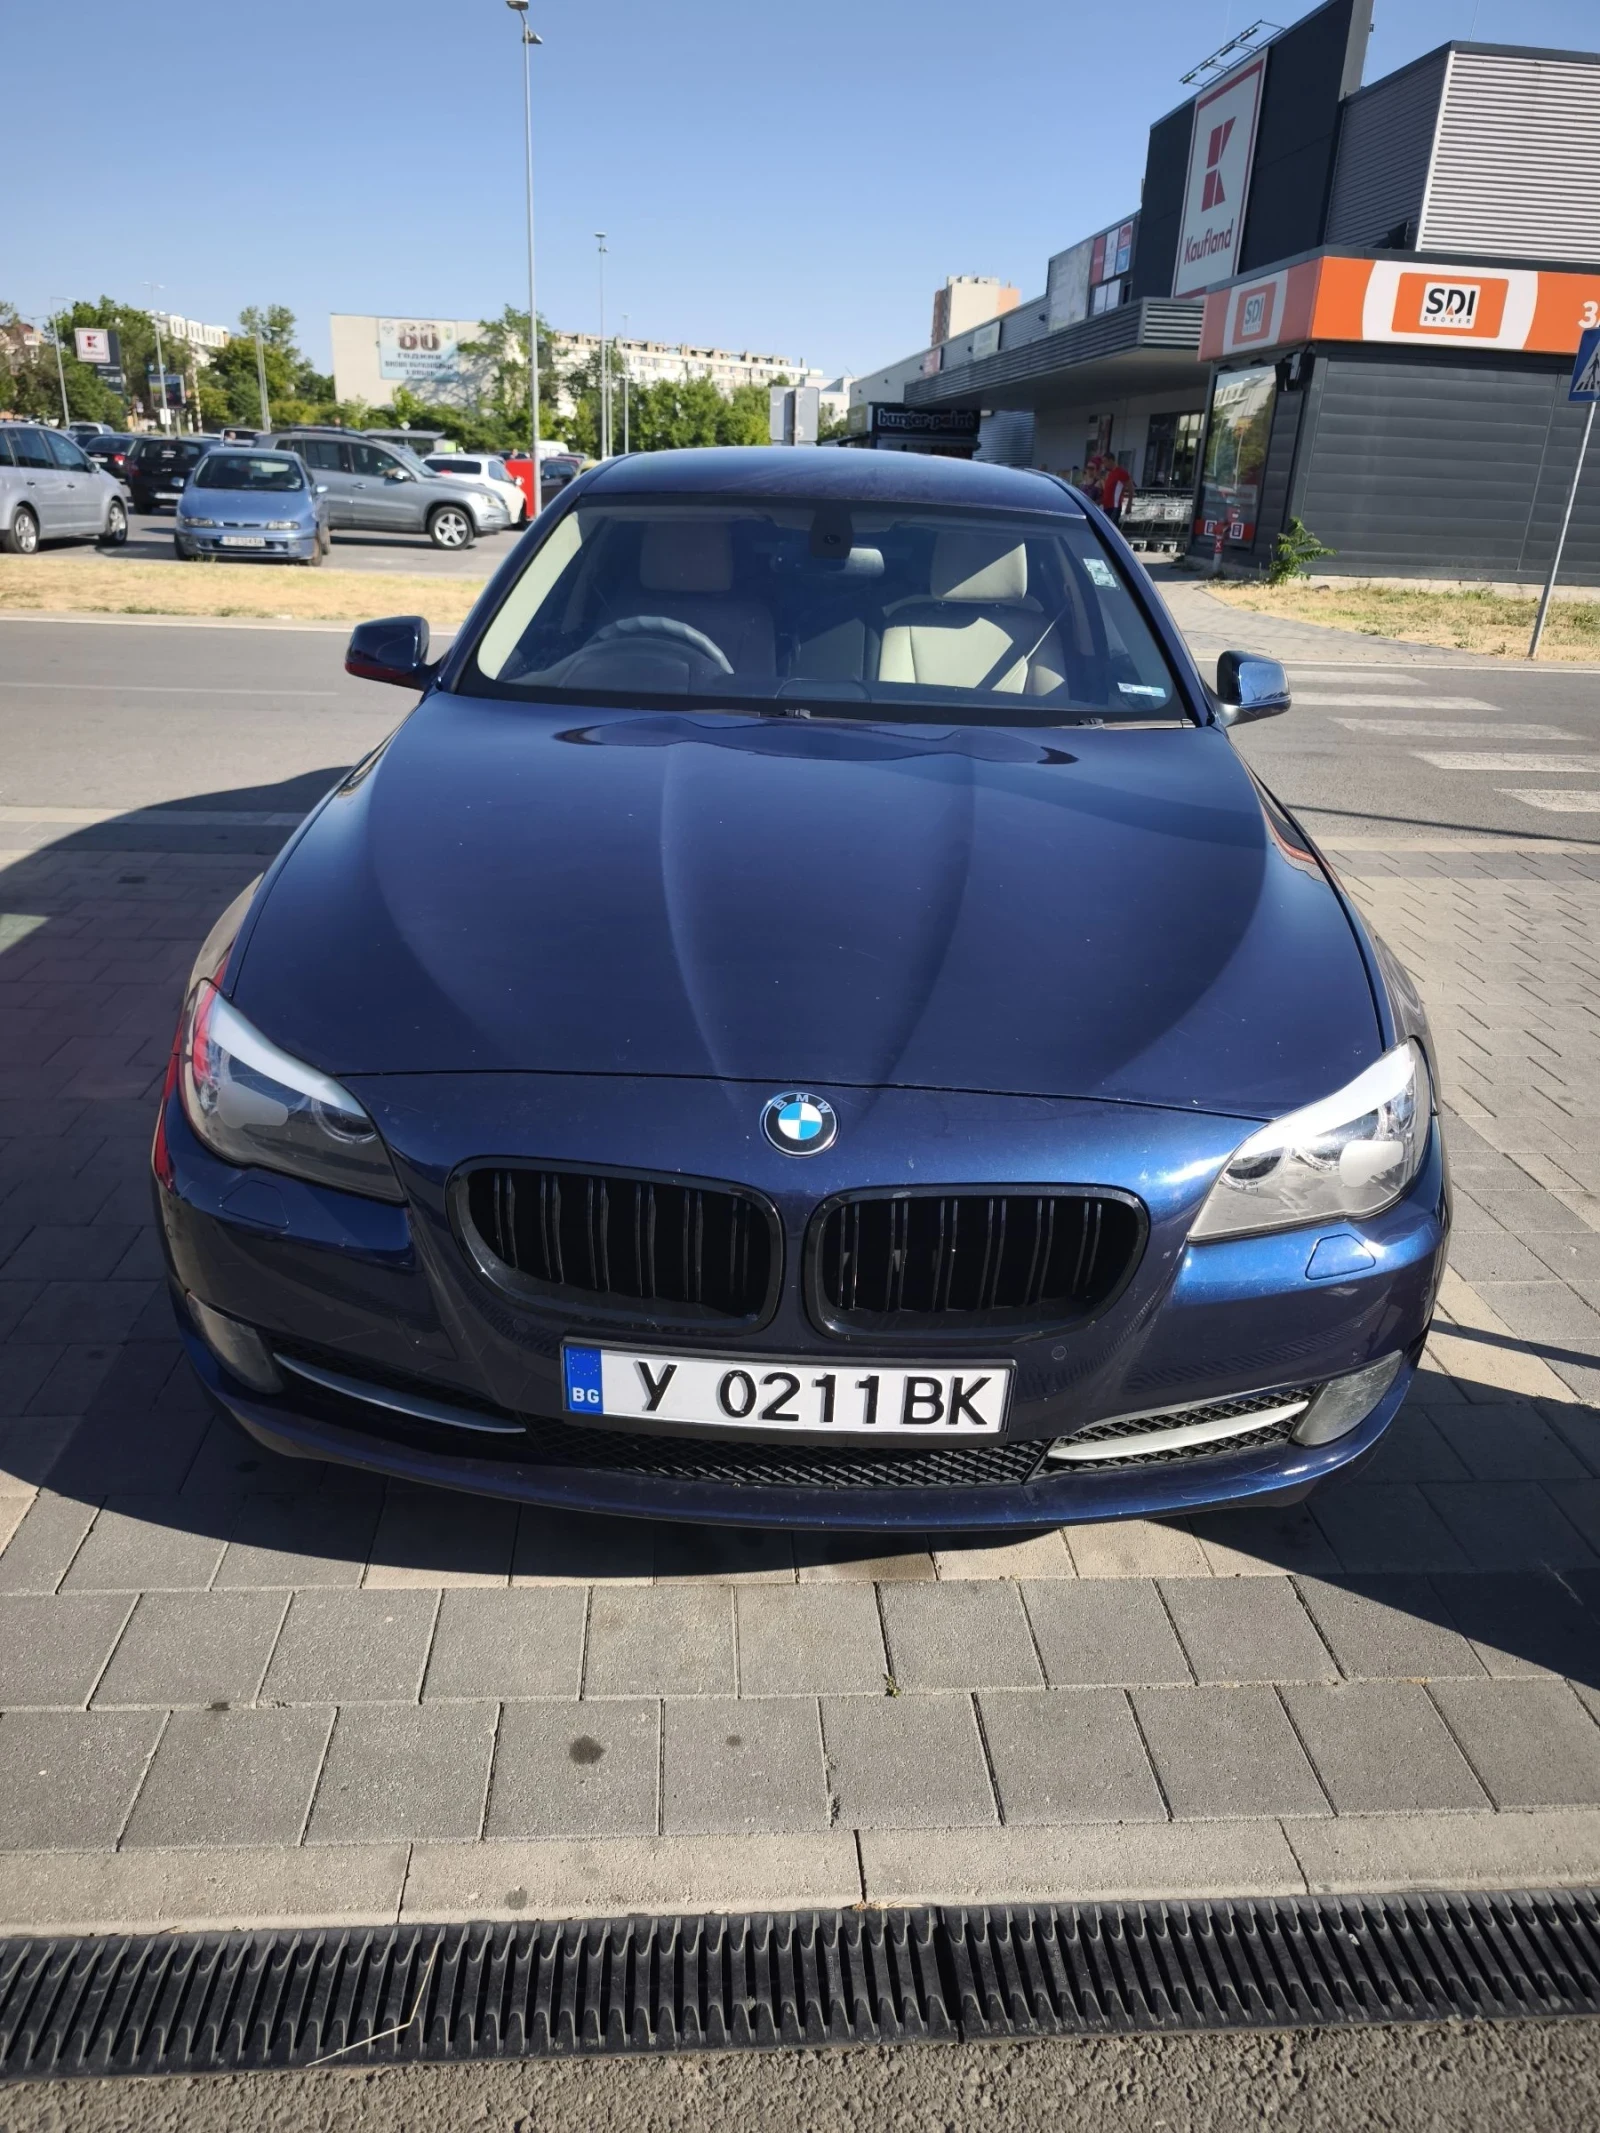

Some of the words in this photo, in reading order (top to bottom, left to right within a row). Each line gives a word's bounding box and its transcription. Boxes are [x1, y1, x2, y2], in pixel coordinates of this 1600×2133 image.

[1183, 218, 1234, 265] Kaufland
[1245, 297, 1264, 325] SDI
[1426, 288, 1476, 316] SDI
[1423, 315, 1471, 324] BROKER
[773, 1093, 832, 1113] BMW
[573, 1387, 600, 1405] BG
